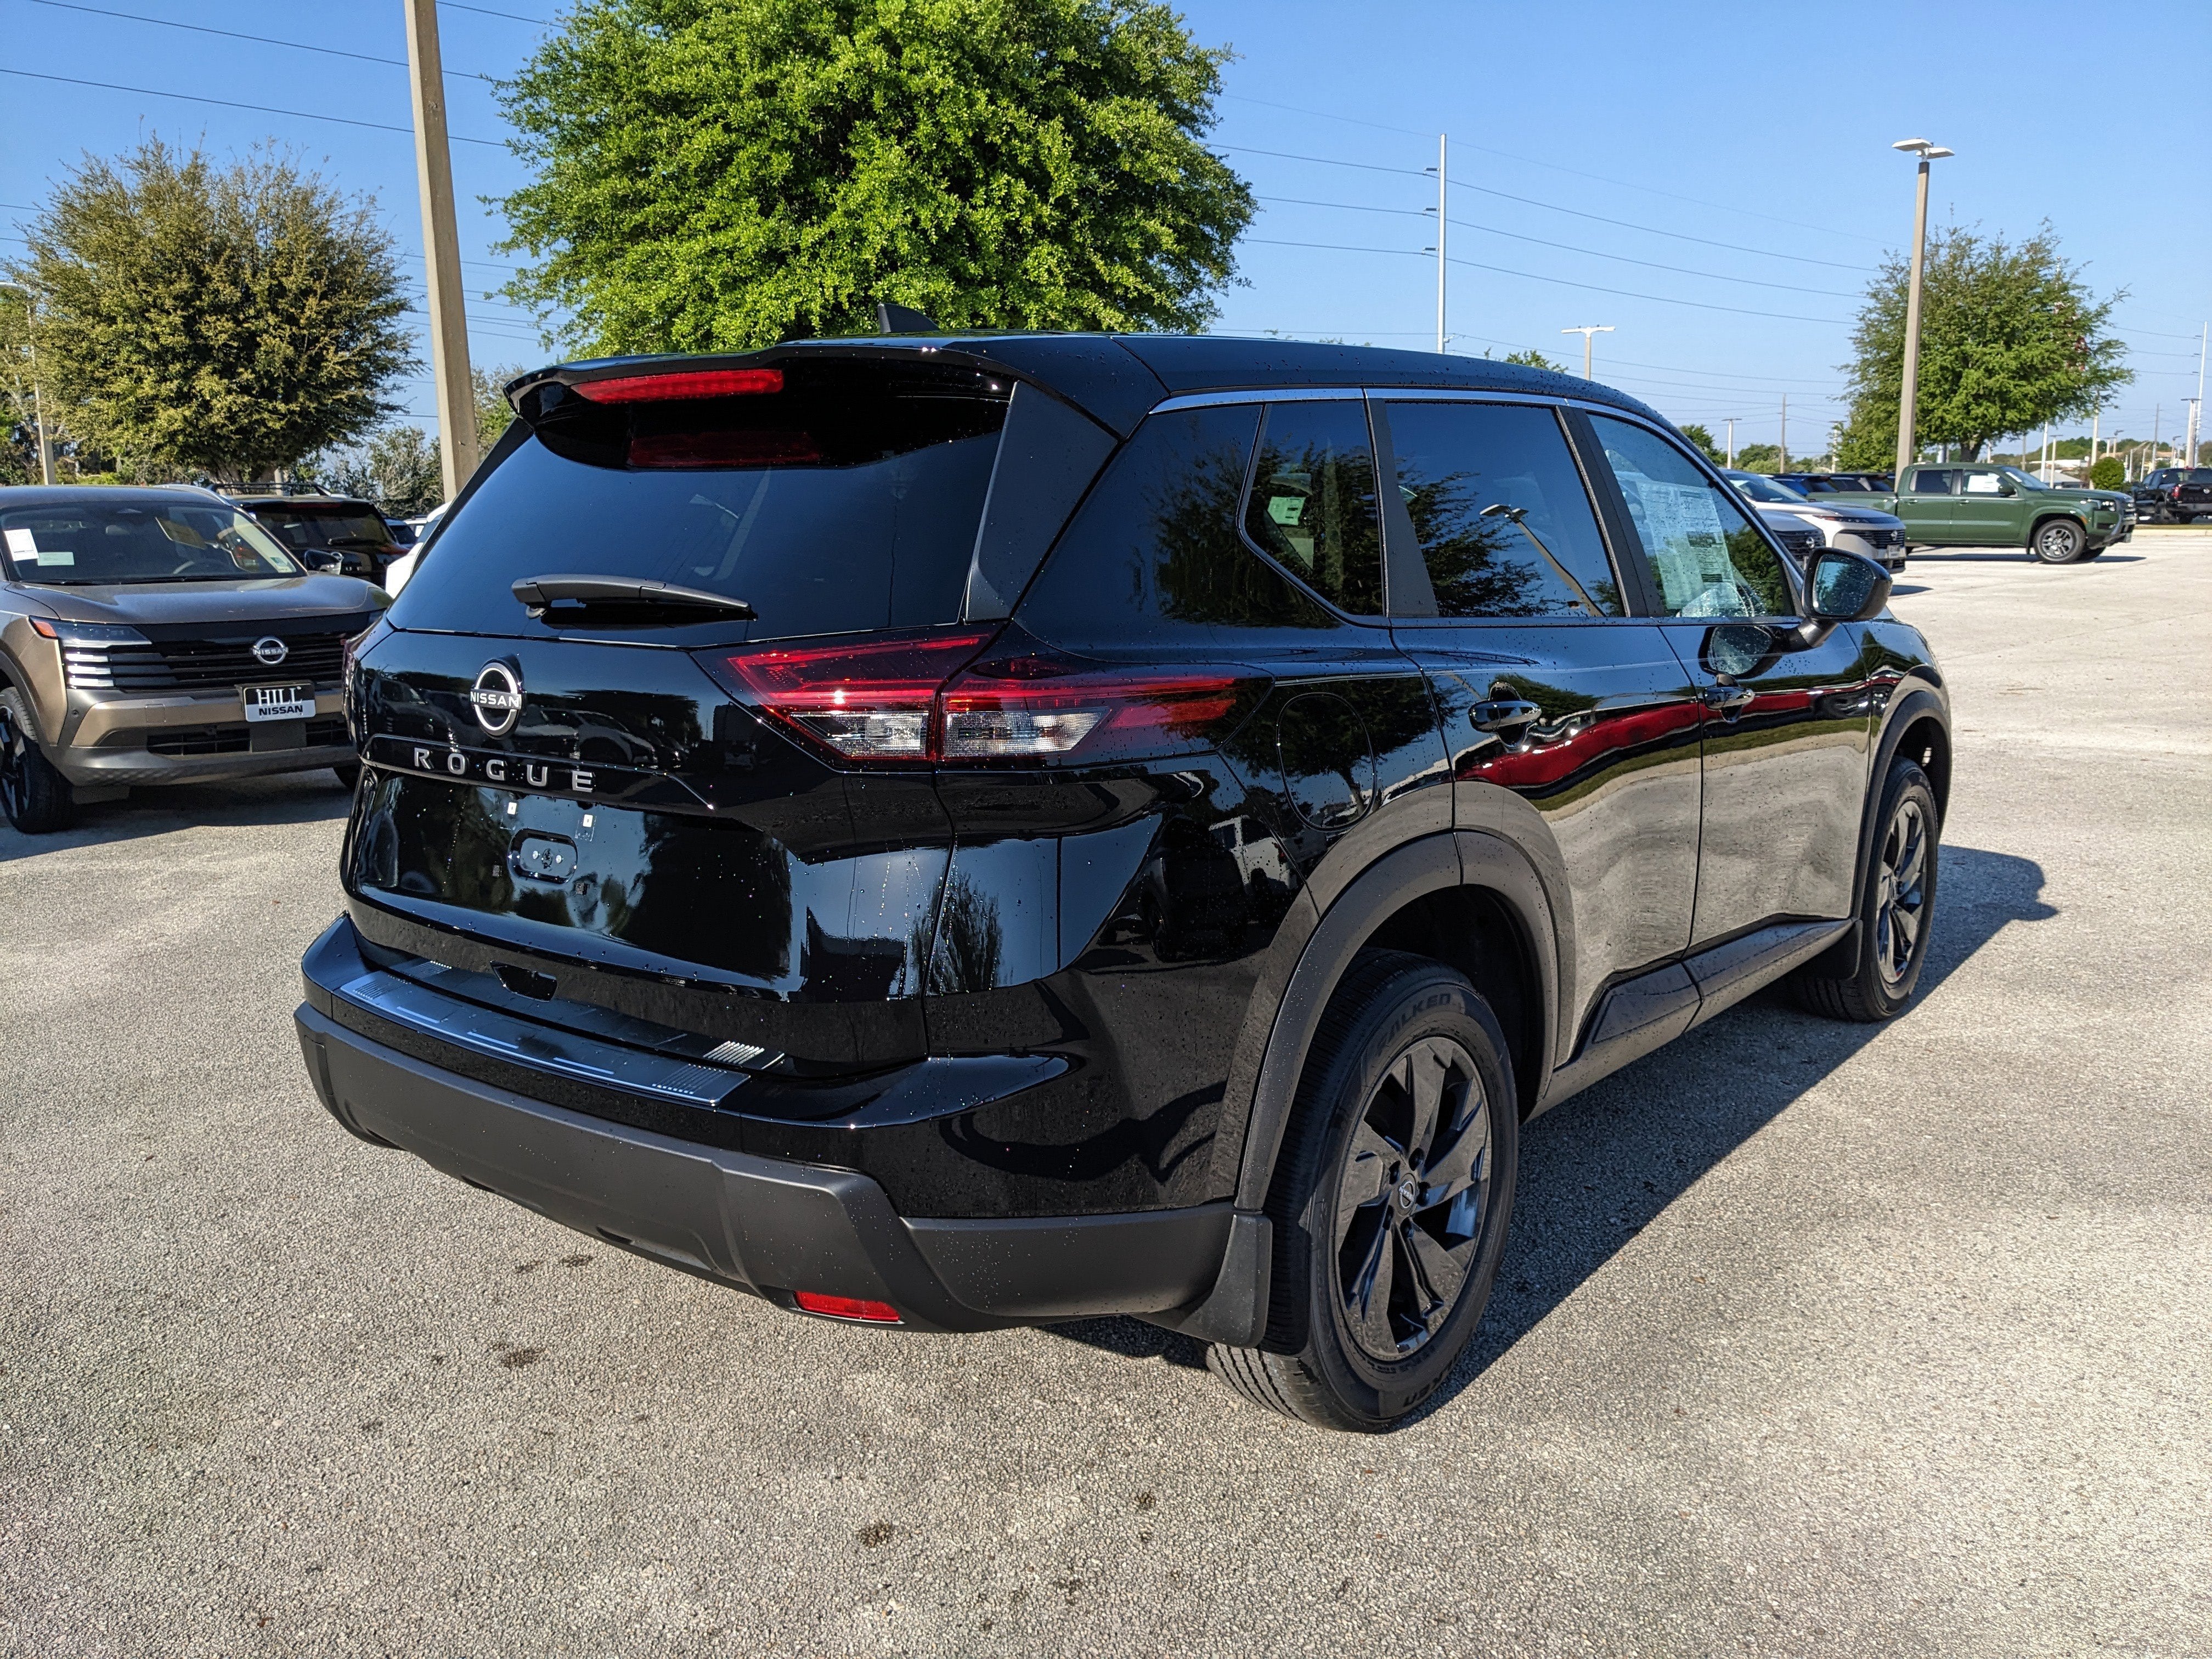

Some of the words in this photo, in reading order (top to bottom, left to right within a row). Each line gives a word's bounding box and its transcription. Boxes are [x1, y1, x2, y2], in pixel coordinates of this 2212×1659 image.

[256, 687, 302, 706] HILL
[470, 691, 520, 707] NISSAN
[258, 705, 303, 715] NISSAN
[414, 747, 594, 793] ROGUE
[1372, 993, 1451, 1057] FALKEN
